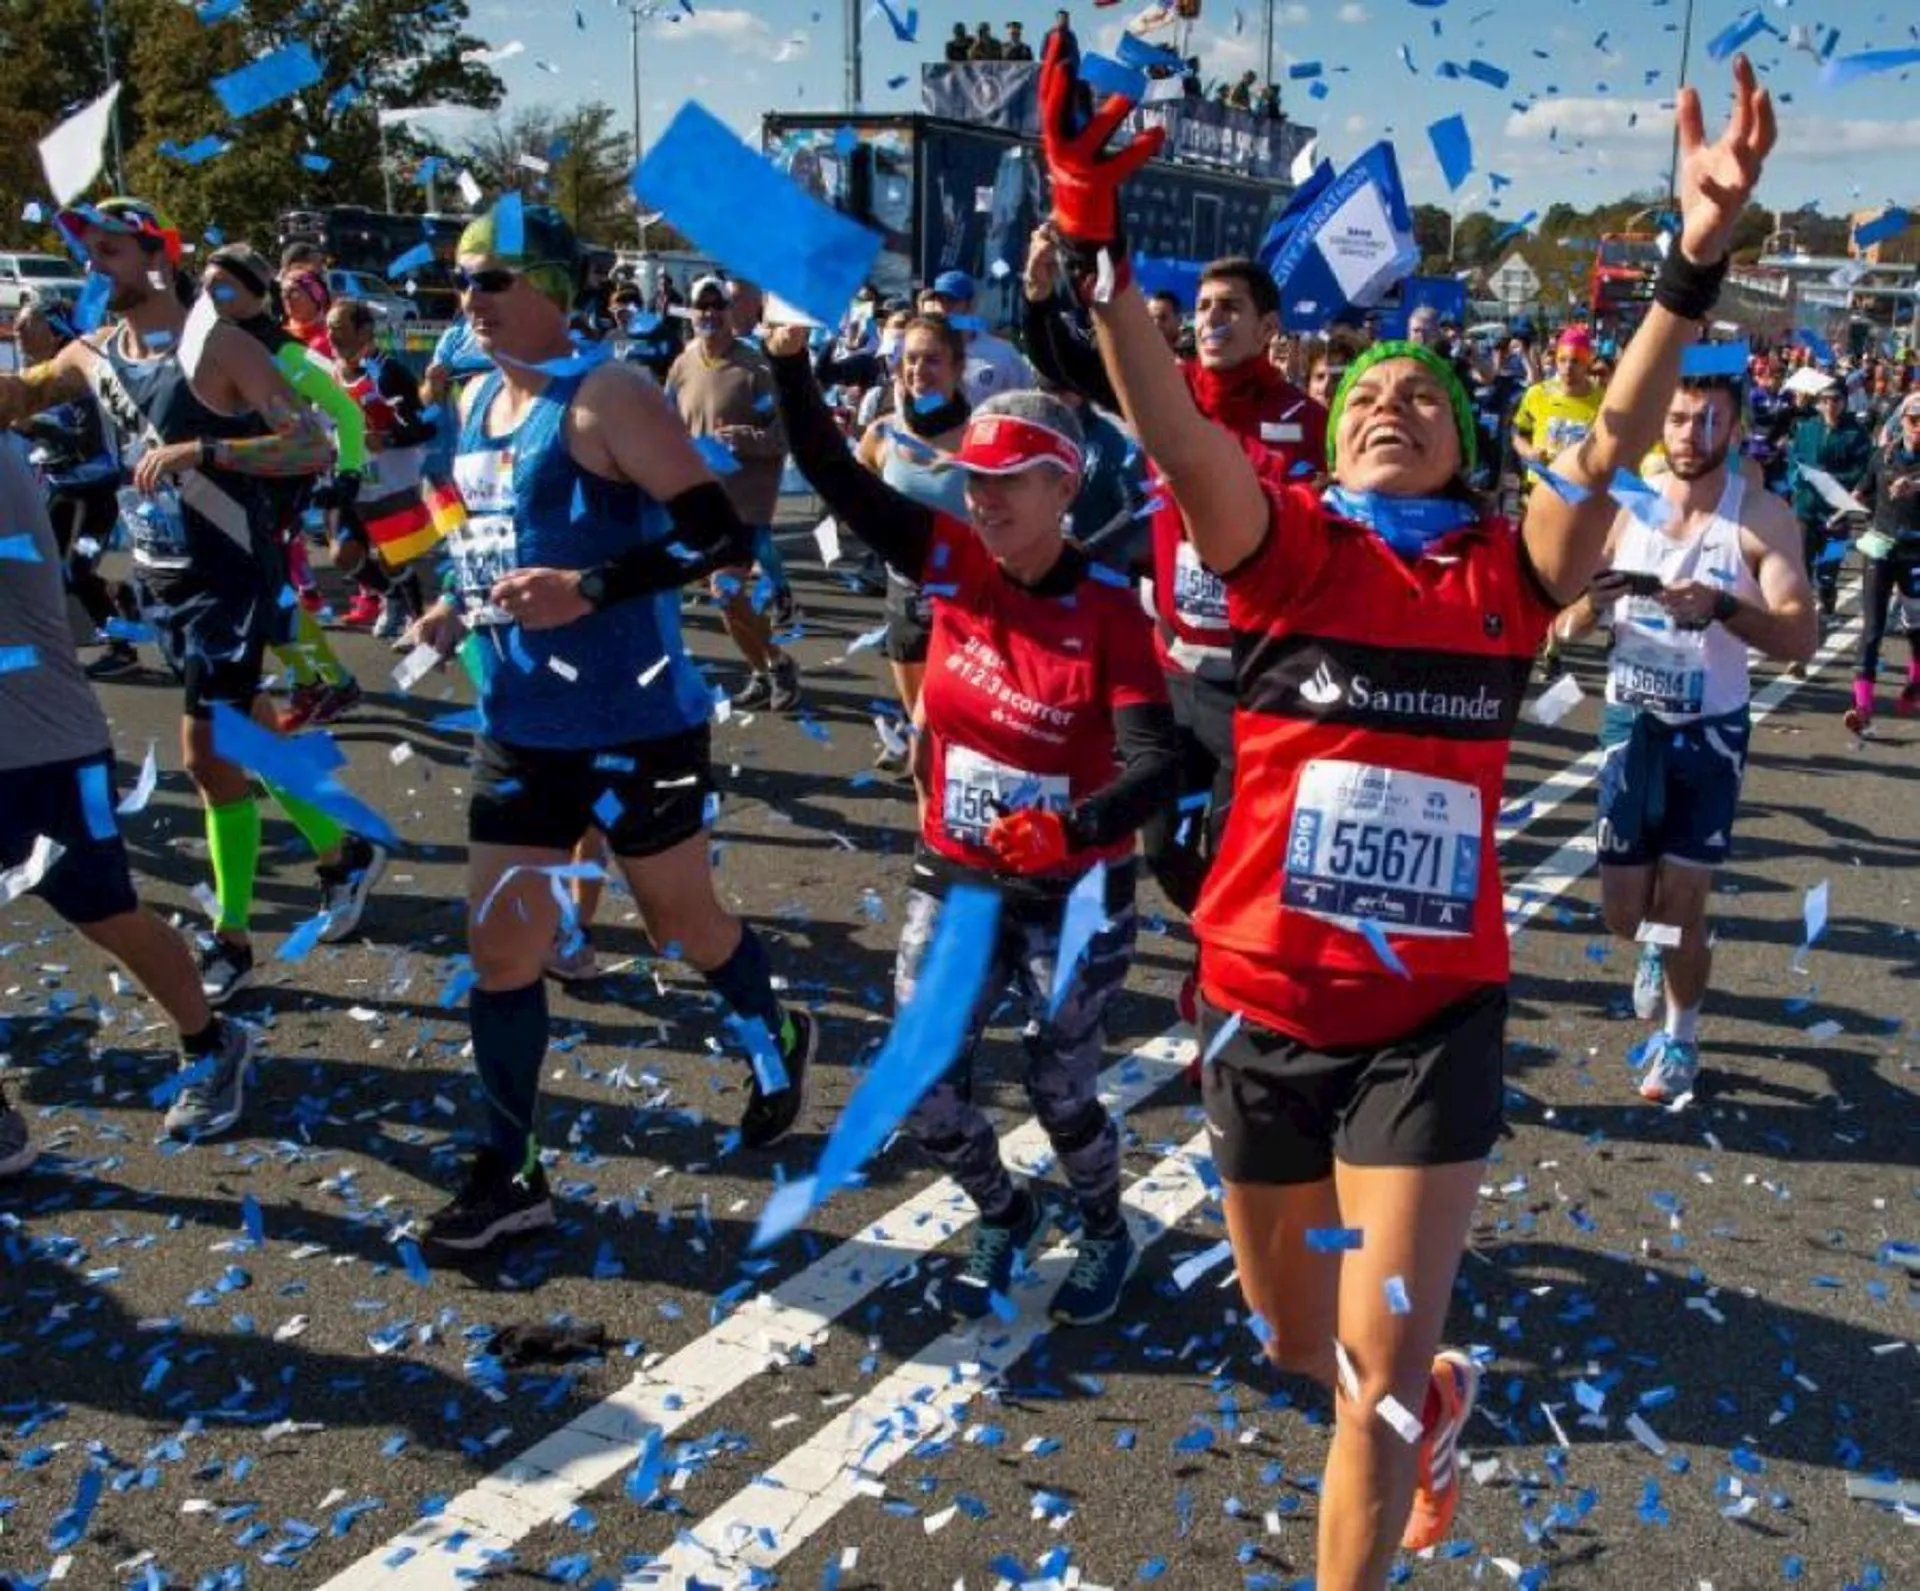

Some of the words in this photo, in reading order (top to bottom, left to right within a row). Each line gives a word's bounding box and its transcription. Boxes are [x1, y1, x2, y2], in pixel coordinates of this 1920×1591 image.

[1296, 164, 1369, 249] MARATHON
[1348, 674, 1502, 720] Santander
[1328, 819, 1444, 888] 55671
